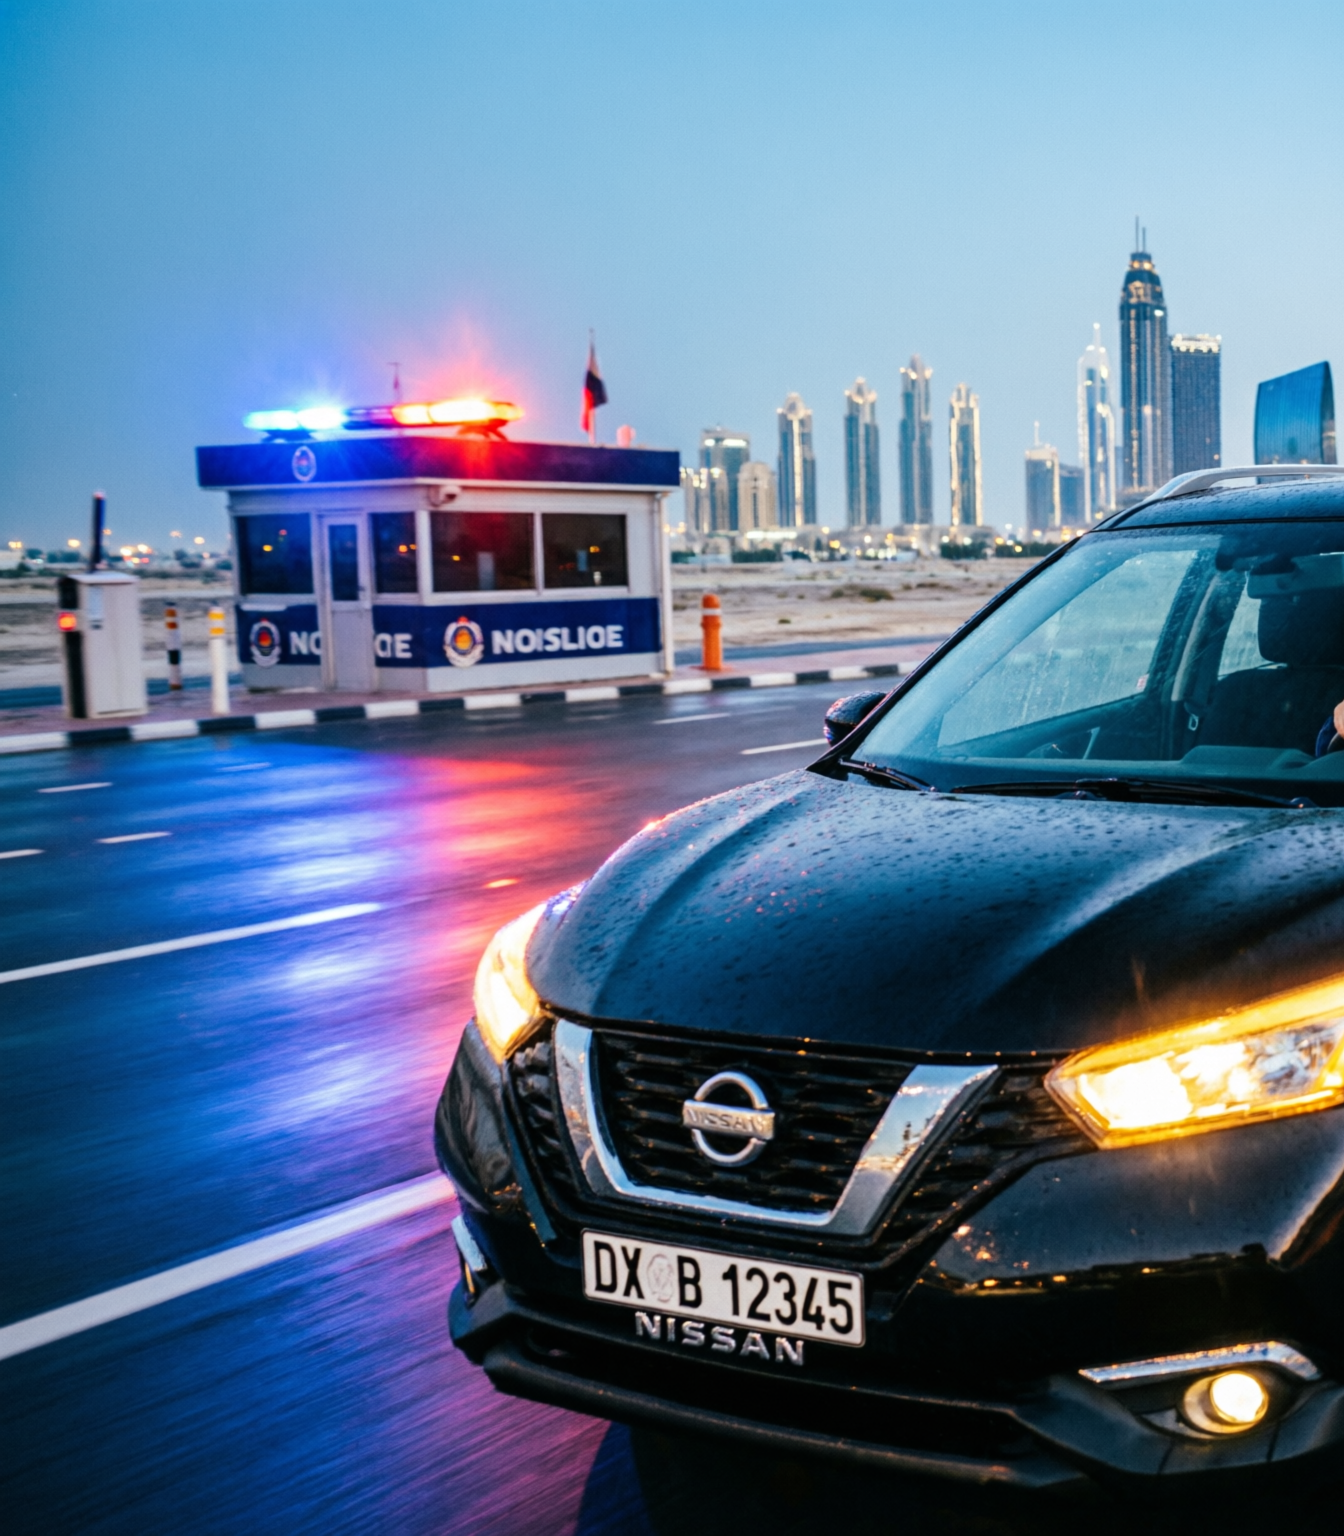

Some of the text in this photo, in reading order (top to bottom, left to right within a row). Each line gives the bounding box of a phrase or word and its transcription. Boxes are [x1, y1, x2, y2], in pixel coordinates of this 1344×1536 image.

[685, 1106, 766, 1133] NISSAN
[593, 1240, 854, 1335] DX B 12345
[634, 1310, 804, 1366] NISSAN
